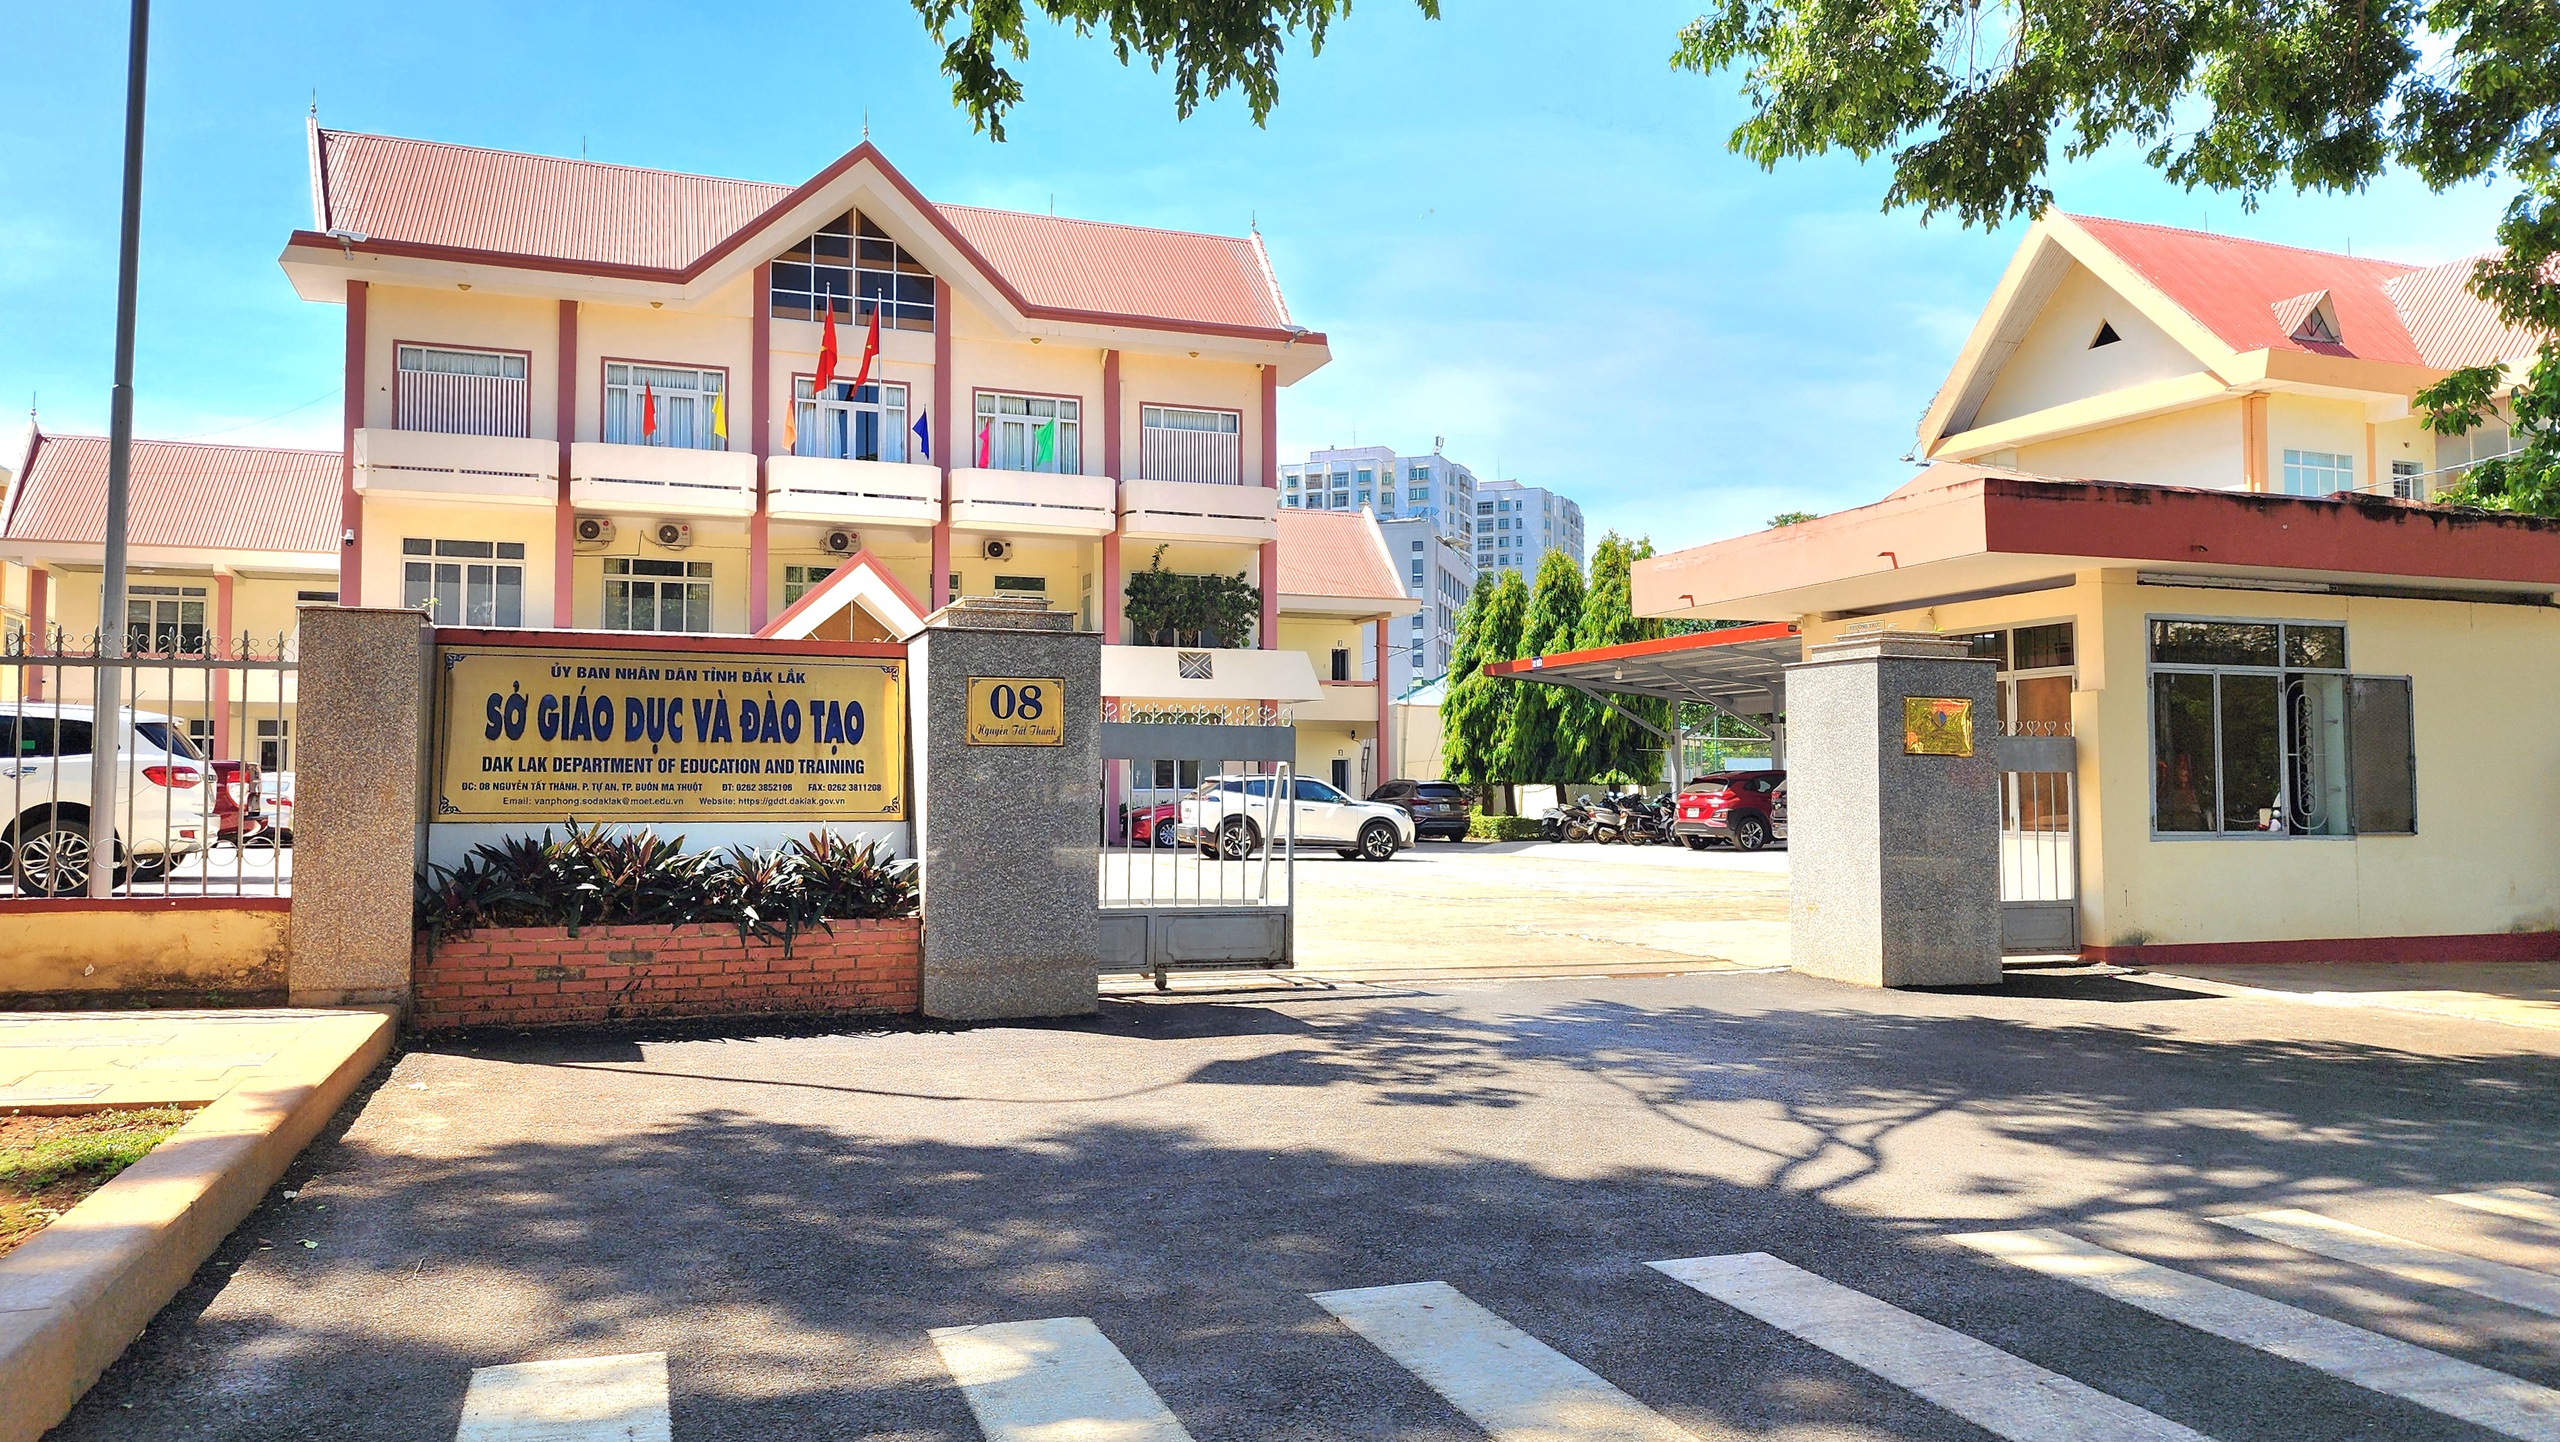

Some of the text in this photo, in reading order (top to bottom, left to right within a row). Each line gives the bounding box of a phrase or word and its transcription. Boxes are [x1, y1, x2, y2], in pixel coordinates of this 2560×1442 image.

[551, 662, 571, 678] ỦY
[577, 666, 610, 678] BAN
[615, 666, 660, 681] NHÂN
[665, 668, 697, 681] DÂN
[702, 668, 737, 683] TỈNH
[990, 684, 1043, 720] 08
[485, 680, 865, 756] SỞ GIÁO DỤC VÀ ĐÀO TẠO
[482, 756, 865, 775] DAK LAK DEPARTMENT OF EDUCATION AND TRAINING
[461, 782, 477, 791] ĐC:
[479, 782, 490, 791] 08
[582, 783, 589, 791] P.
[592, 782, 603, 793] TỰ
[622, 783, 633, 791] TP.
[661, 783, 675, 792] MA
[677, 781, 703, 794] THUỘT
[721, 783, 734, 792] ĐT:
[736, 783, 756, 792] 0262
[808, 783, 825, 792] FAX:
[827, 783, 847, 792] 0262
[848, 783, 882, 792] 3811208
[503, 797, 532, 805] Email:
[699, 797, 736, 806] Website:
